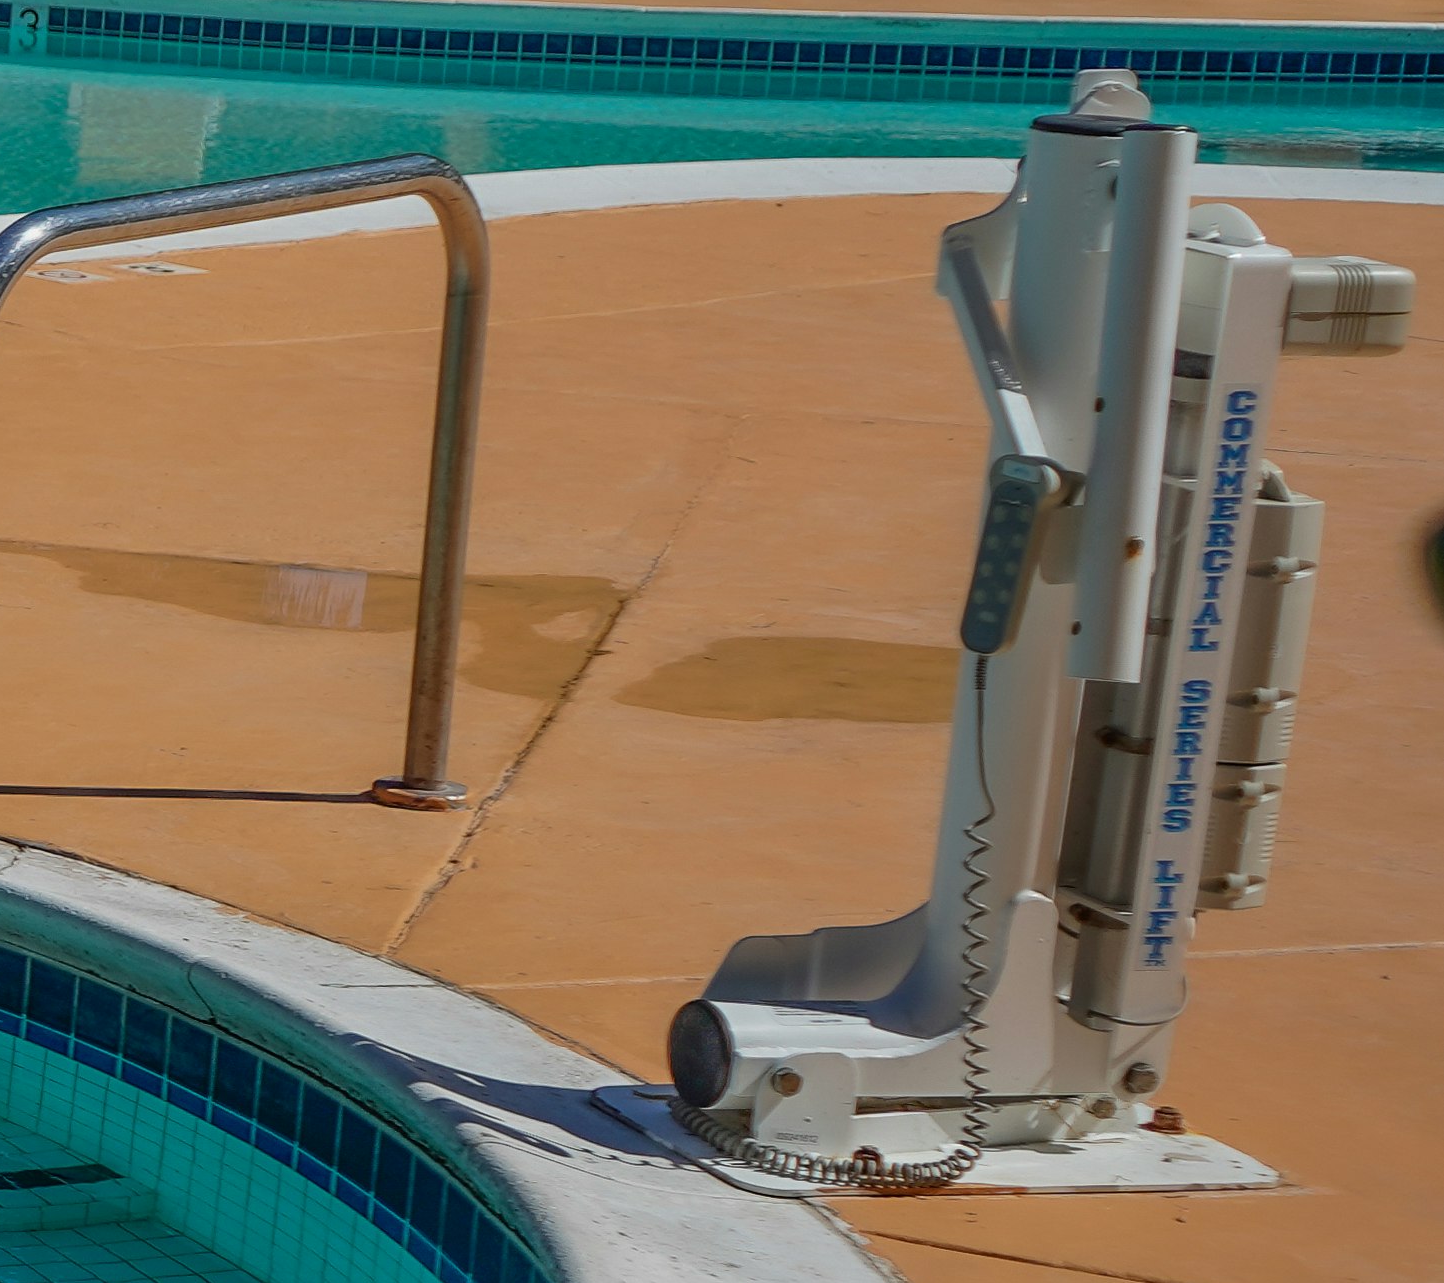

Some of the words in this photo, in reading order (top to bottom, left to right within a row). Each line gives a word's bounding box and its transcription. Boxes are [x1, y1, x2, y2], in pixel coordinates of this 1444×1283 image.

[1186, 390, 1258, 653] COMMERCIAL
[1161, 679, 1213, 833] SERIES
[1142, 859, 1185, 959] LIFT
